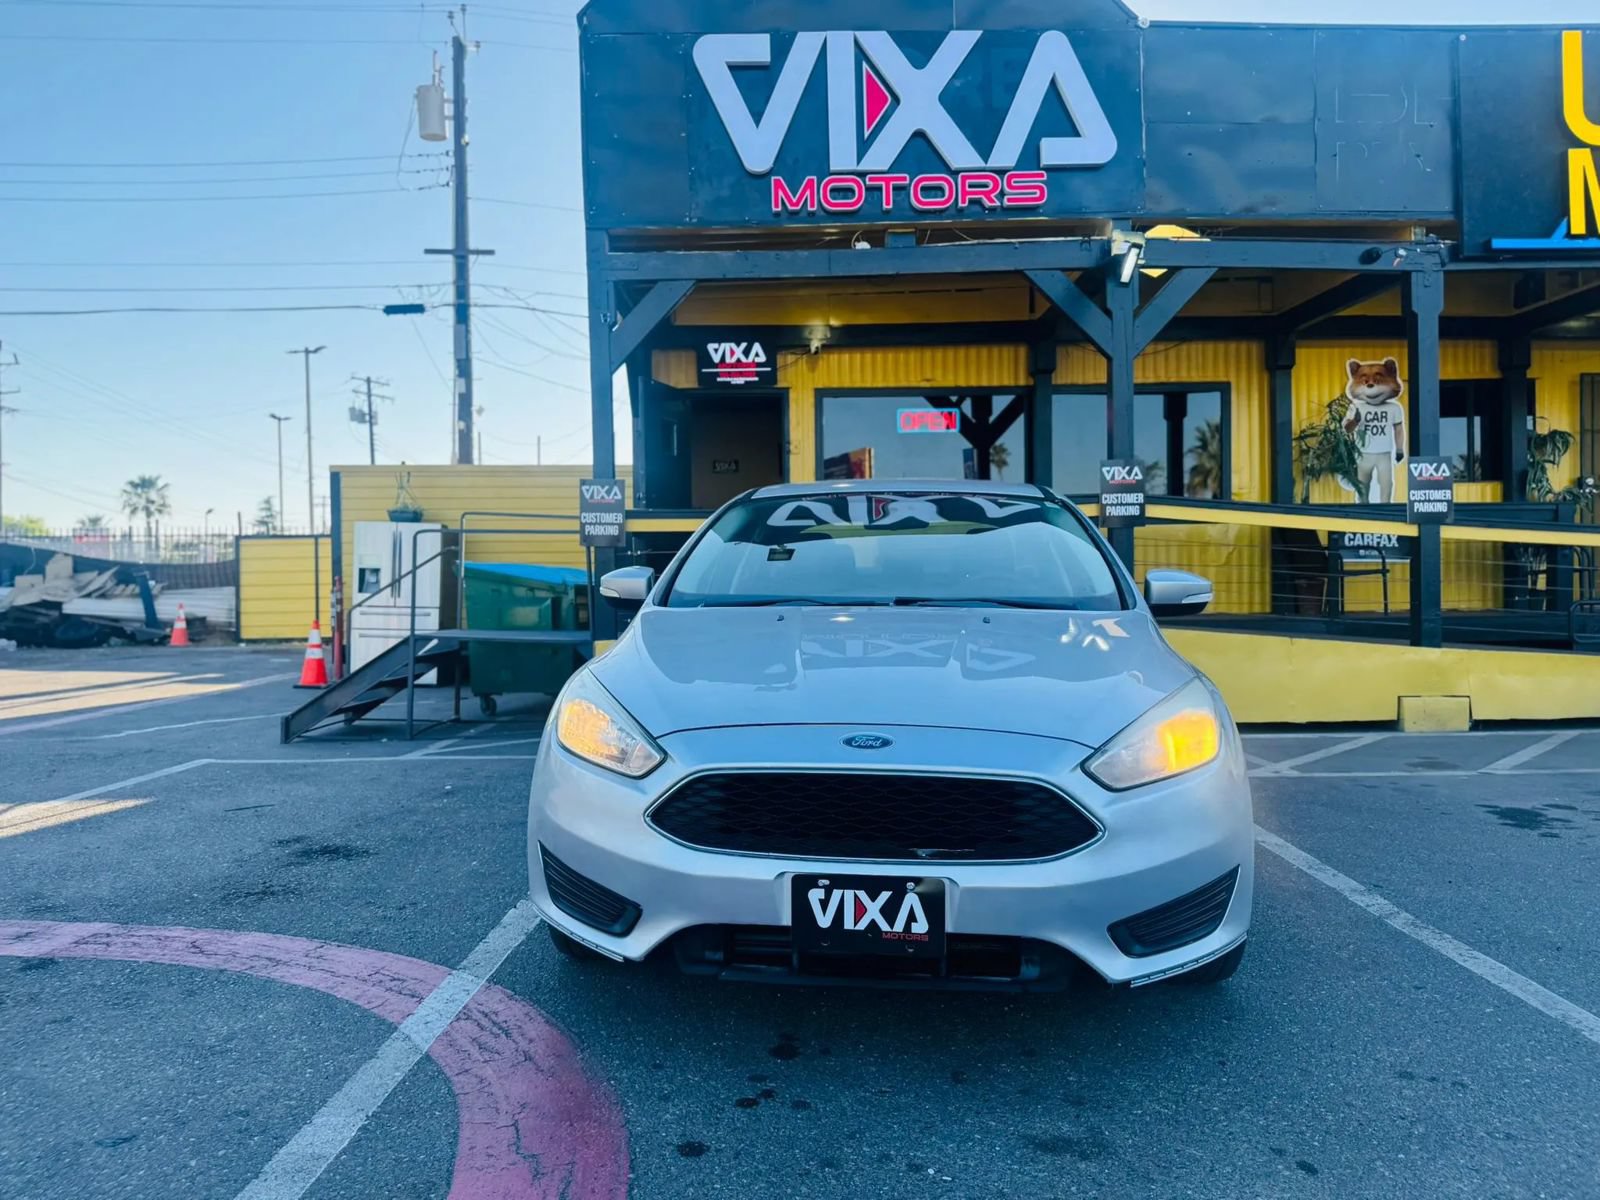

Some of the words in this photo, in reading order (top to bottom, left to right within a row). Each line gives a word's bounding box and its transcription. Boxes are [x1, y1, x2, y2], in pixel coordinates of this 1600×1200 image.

[692, 30, 1118, 174] VIXA
[771, 171, 1048, 213] MOTORS
[706, 342, 767, 364] VIXA
[901, 411, 957, 431] OPEN
[1364, 411, 1388, 423] CAR
[1364, 424, 1387, 437] FOX
[1101, 465, 1143, 480] VIXA
[1409, 462, 1451, 477] VIXA
[581, 485, 622, 500] VIXA
[1102, 493, 1144, 504] CUSTOMER
[1409, 489, 1452, 501] CUSTOMER
[1106, 505, 1140, 516] PARKING
[1413, 501, 1448, 513] PARKING
[581, 512, 623, 524] CUSTOMER
[585, 524, 619, 536] PARKING
[1344, 532, 1399, 548] CARFAX
[851, 735, 883, 747] Ford
[807, 887, 929, 934] VIXA
[881, 932, 929, 942] MOTORS
